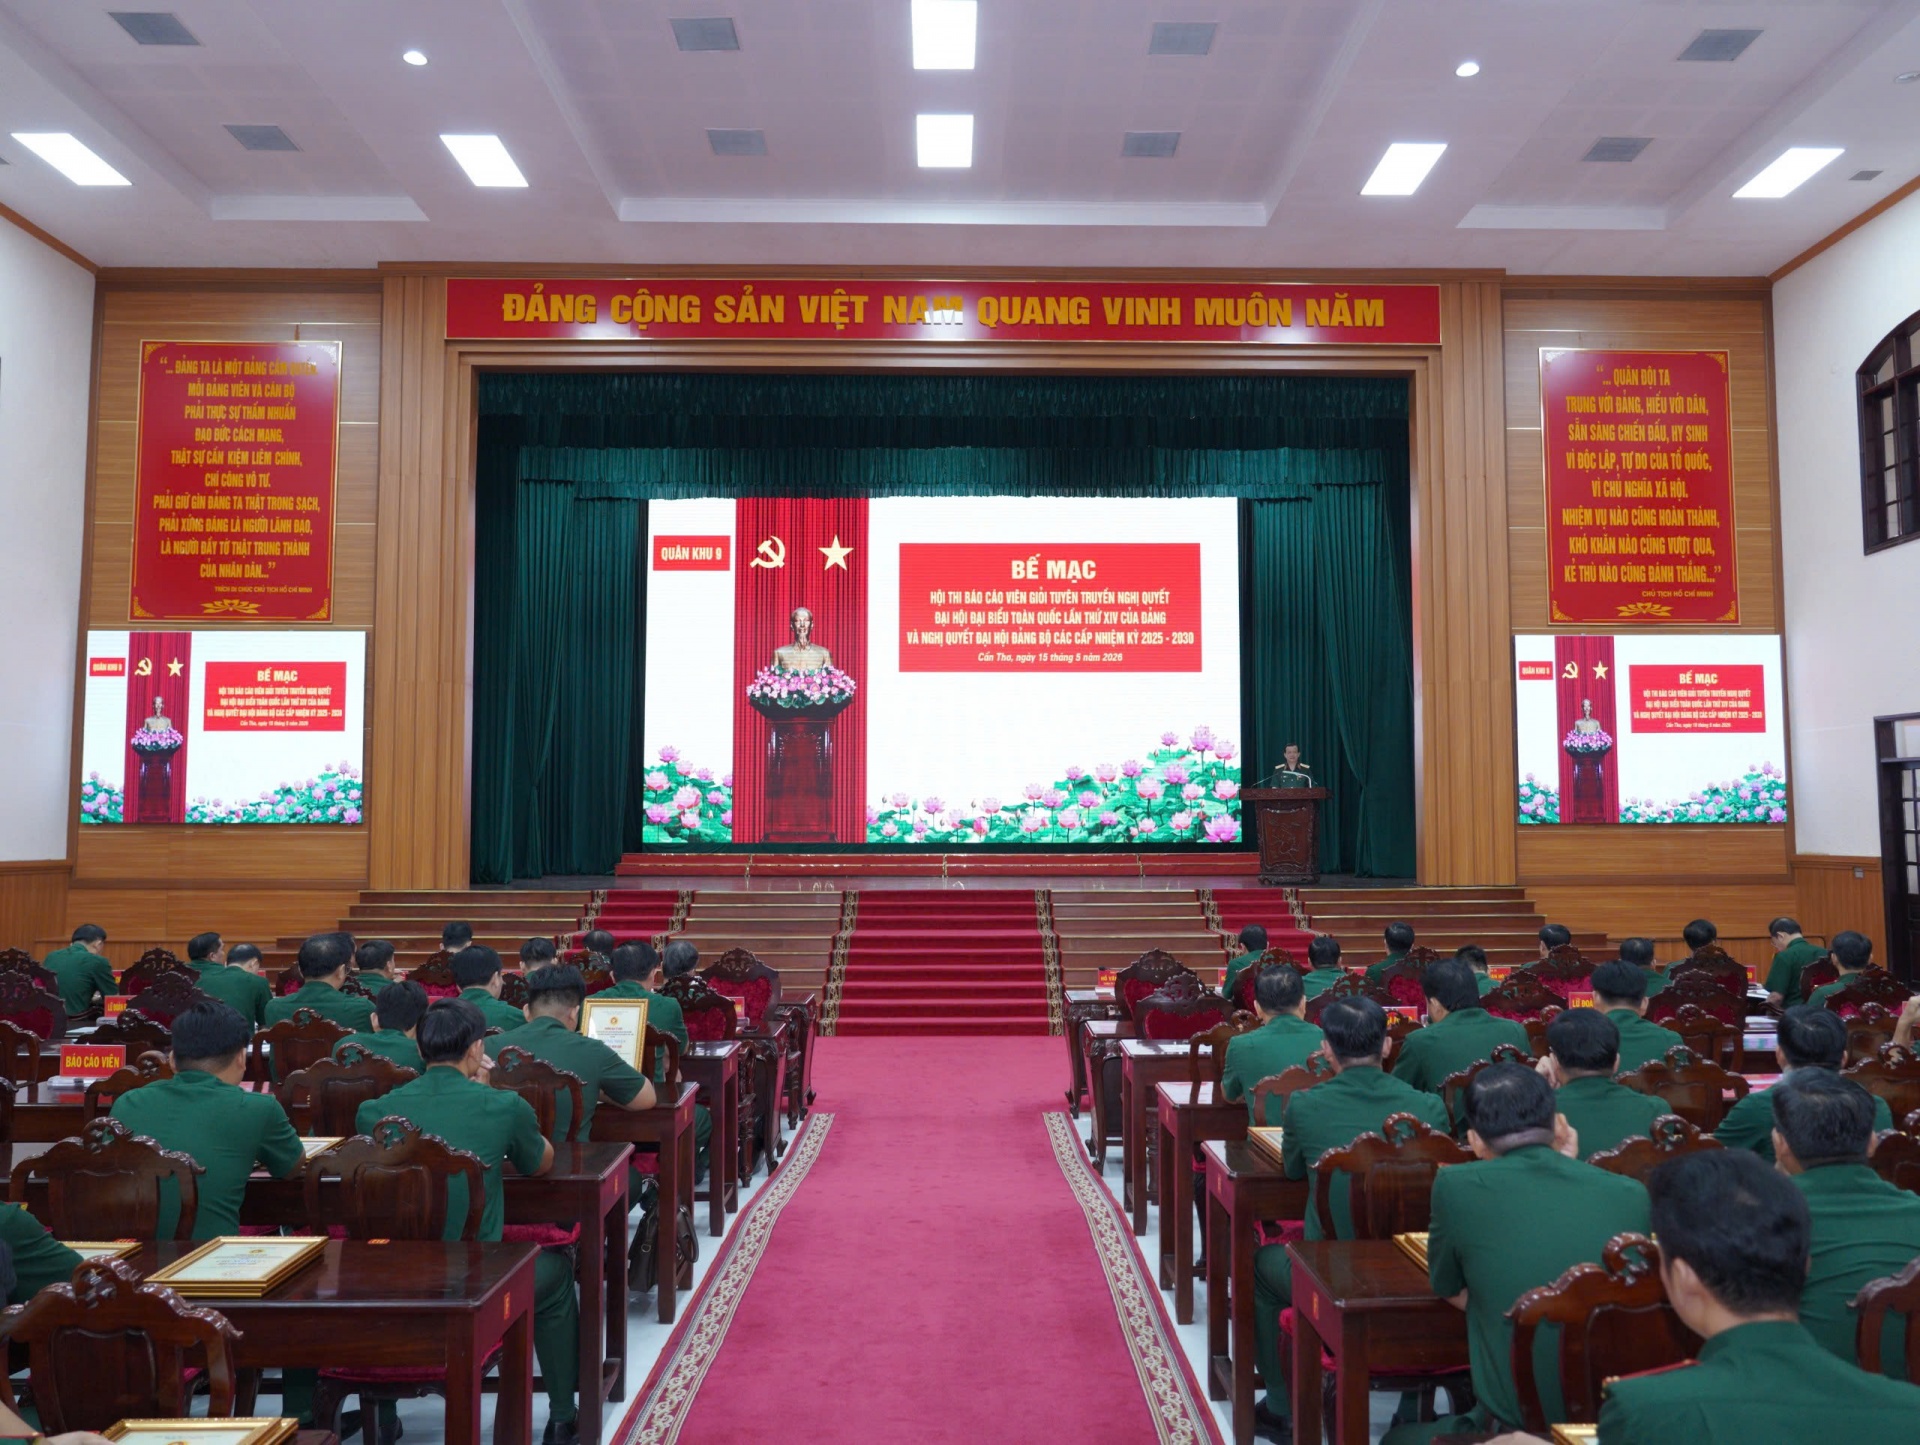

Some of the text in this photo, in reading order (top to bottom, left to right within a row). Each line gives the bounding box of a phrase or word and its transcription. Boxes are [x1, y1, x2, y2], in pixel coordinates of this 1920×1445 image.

[502, 283, 1384, 330] ĐẢNG CỘNG SẢN VIỆT NAM QUANG VINH MUÔN NĂM
[175, 355, 198, 374] ĐẢNG
[200, 360, 210, 374] TA
[212, 358, 222, 375] LÀ
[225, 358, 243, 378] MỘT
[1614, 365, 1670, 390] QUÂN ĐỘI TA
[206, 378, 295, 400] ĐẢNG VIÊN VÀ CÁN BỘ
[185, 400, 241, 422] PHẢI SỰ
[1565, 389, 1708, 415] TRUNG VỚI ĐẢNG, HIẾU VỚI DÂN,
[195, 424, 283, 445] ĐẠO ĐỨC CÁCH MẠNG,
[1590, 421, 1615, 441] SÀNG
[1618, 419, 1645, 441] CHIẾN
[1648, 419, 1669, 443] ĐẤU,
[1671, 425, 1683, 442] HY
[1686, 425, 1708, 442] SINH
[171, 448, 302, 467] THẬT SỰ KIỆM LIÊM CHÍNH,
[1566, 448, 1575, 469] VÌ
[1577, 449, 1596, 473] ĐỘC
[1621, 451, 1633, 473] TỰ
[1635, 452, 1647, 469] DO
[1650, 445, 1668, 469] CỦA
[1671, 446, 1682, 470] TỔ
[1684, 447, 1712, 472] QUỐC,
[205, 471, 270, 487] CHÍ CÔNG VÔ TƯ.
[1592, 473, 1688, 501] VÌ CHỦ NGHĨA XÃ HỘI.
[1562, 505, 1719, 529] NHIỆM VỤ NÀO CŨNG HOÀN THÀNH,
[661, 545, 722, 561] QUÂN KHU 9
[1569, 533, 1715, 558] KHÓ KHĂN NÀO CŨNG VƯỢT QUA,
[200, 558, 217, 578] CỦA
[219, 561, 242, 578] NHÂN
[1012, 554, 1096, 583] BẾ MẠC
[1565, 558, 1576, 582] KẺ
[1579, 562, 1596, 582] THÙ
[1599, 562, 1618, 582] NÀO
[1621, 562, 1646, 582] CŨNG
[1648, 562, 1674, 582] ĐÁNH
[930, 589, 945, 606] HỘI
[948, 591, 962, 604] THI
[965, 589, 983, 604] BÁO
[985, 589, 1003, 604] CÁO
[1006, 589, 1027, 604] VIÊN
[1029, 587, 1047, 604] GIỎI
[1050, 589, 1078, 604] TUYÊN
[1118, 592, 1139, 606] NGHỊ
[1142, 588, 1170, 605] QUYẾT
[935, 612, 950, 626] ĐẠI
[952, 609, 967, 626] HỘI
[970, 612, 985, 626] ĐẠI
[1011, 609, 1034, 624] TOÀN
[1037, 608, 1061, 625] QUỐC
[1084, 608, 1102, 624] THỨ
[1104, 612, 1118, 624] XIV
[1120, 607, 1139, 624] CỦA
[1141, 607, 1166, 624] ĐẢNG
[907, 627, 1194, 647] VÀ NGHỊ QUYẾT ĐẠI HỘI ĐẢNG BỘ CÁC CẤP NHIỆM KỲ 2025 2030
[1016, 653, 1036, 663] ngày
[1039, 653, 1048, 661] 15
[1050, 653, 1073, 663] tháng
[1076, 653, 1081, 661] 5
[1102, 653, 1122, 661] 2026
[257, 667, 297, 683] BẾ MẠC
[1679, 670, 1717, 686] BẾ MẠC
[66, 1053, 119, 1068] BÁO CÁO VIÊN
